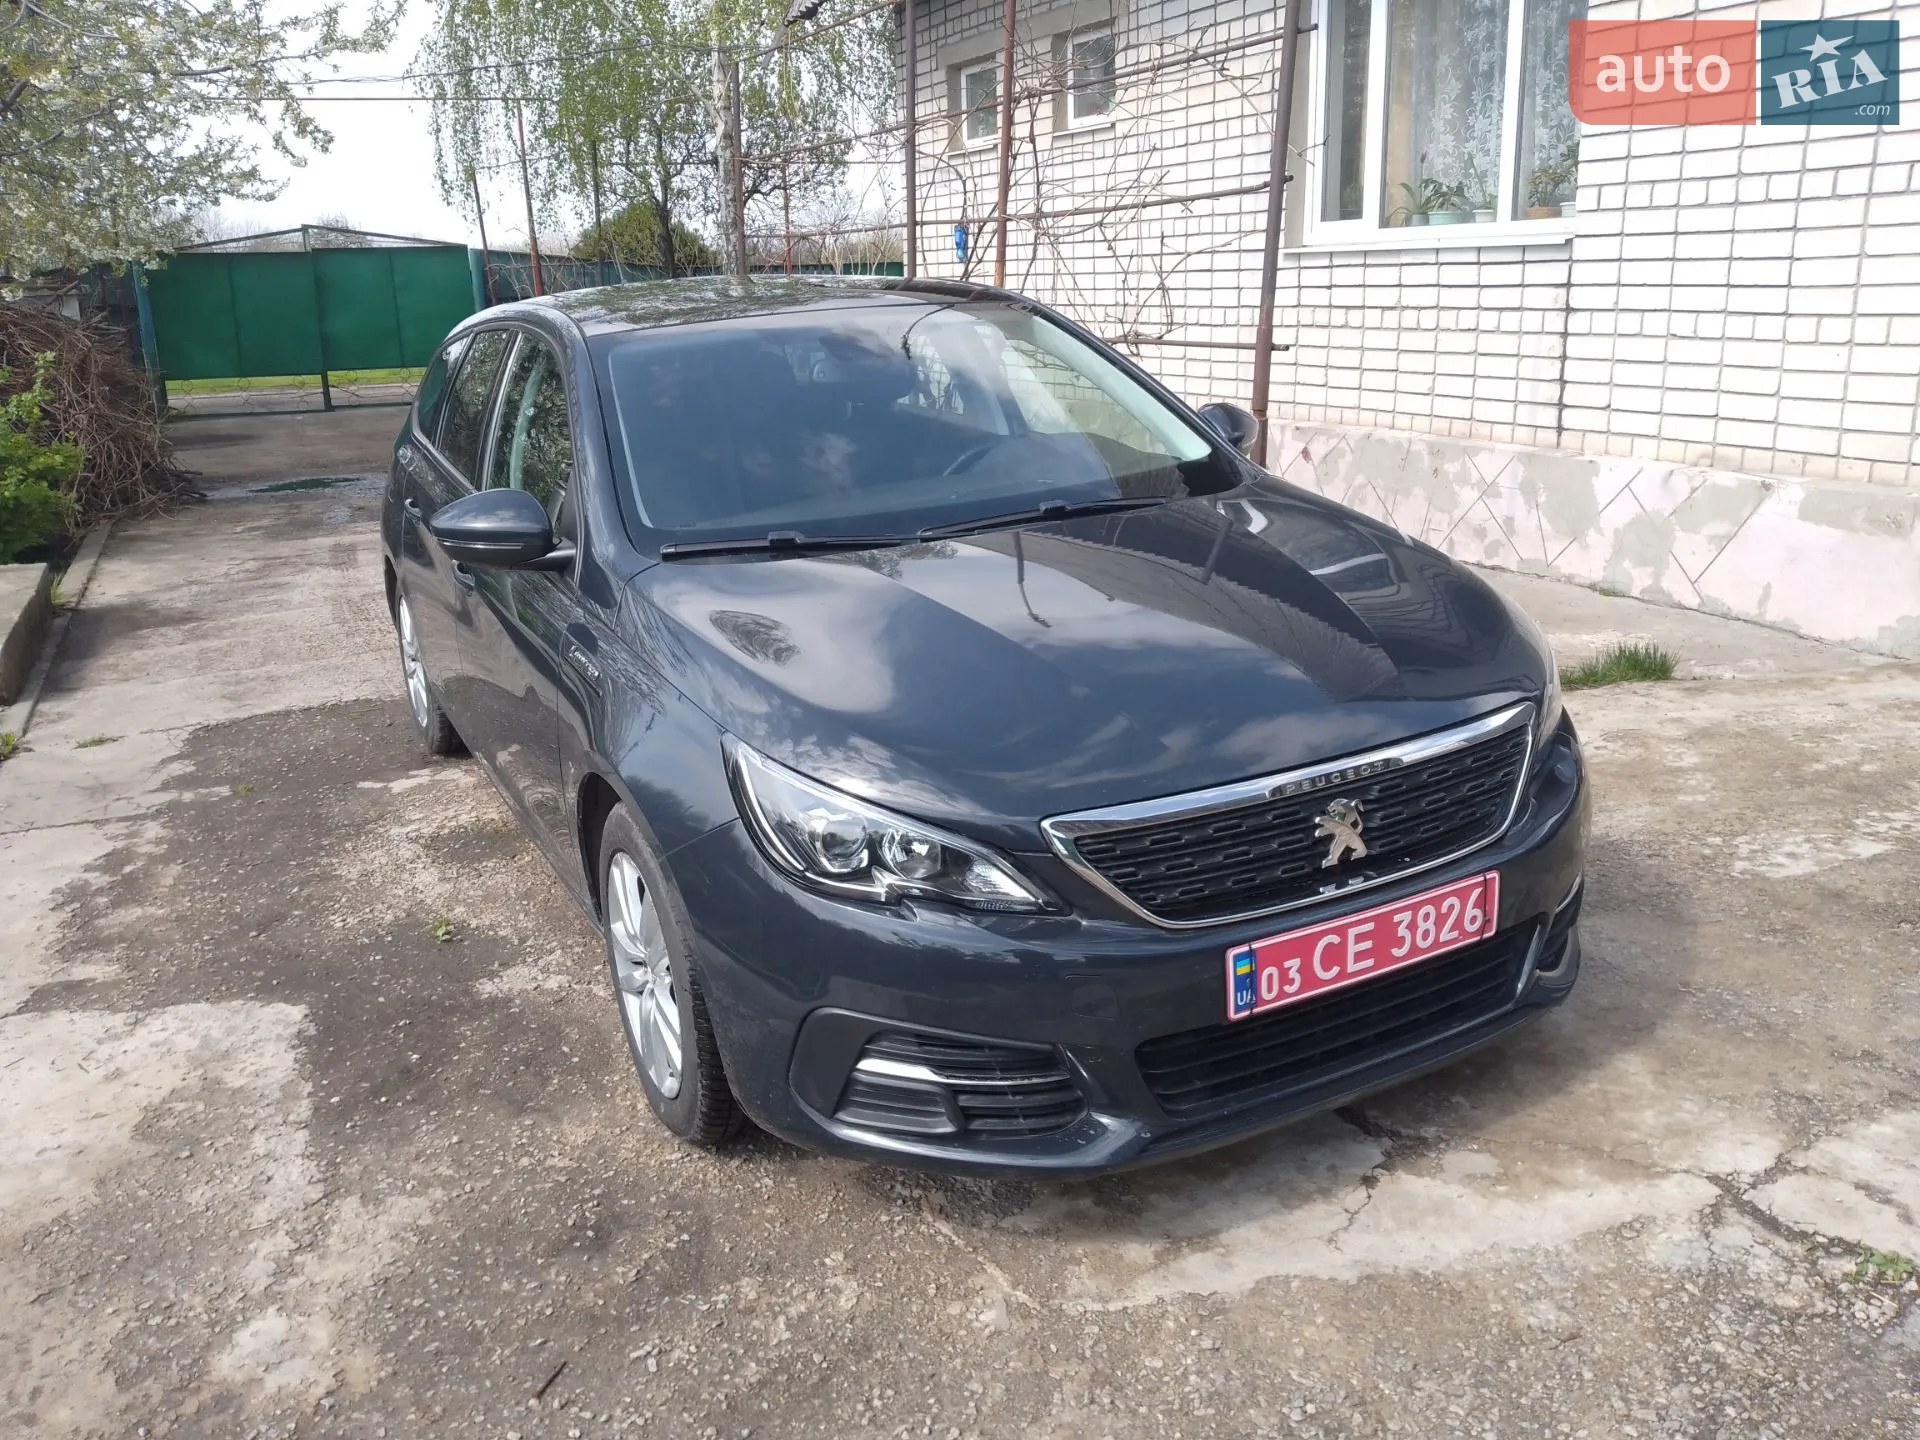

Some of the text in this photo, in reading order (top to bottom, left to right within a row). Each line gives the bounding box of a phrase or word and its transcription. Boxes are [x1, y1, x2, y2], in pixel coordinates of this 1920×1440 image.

[1285, 760, 1385, 795] PEUGEOT
[1261, 886, 1484, 1001] 03 CE 3826
[1236, 989, 1256, 1006] UA
